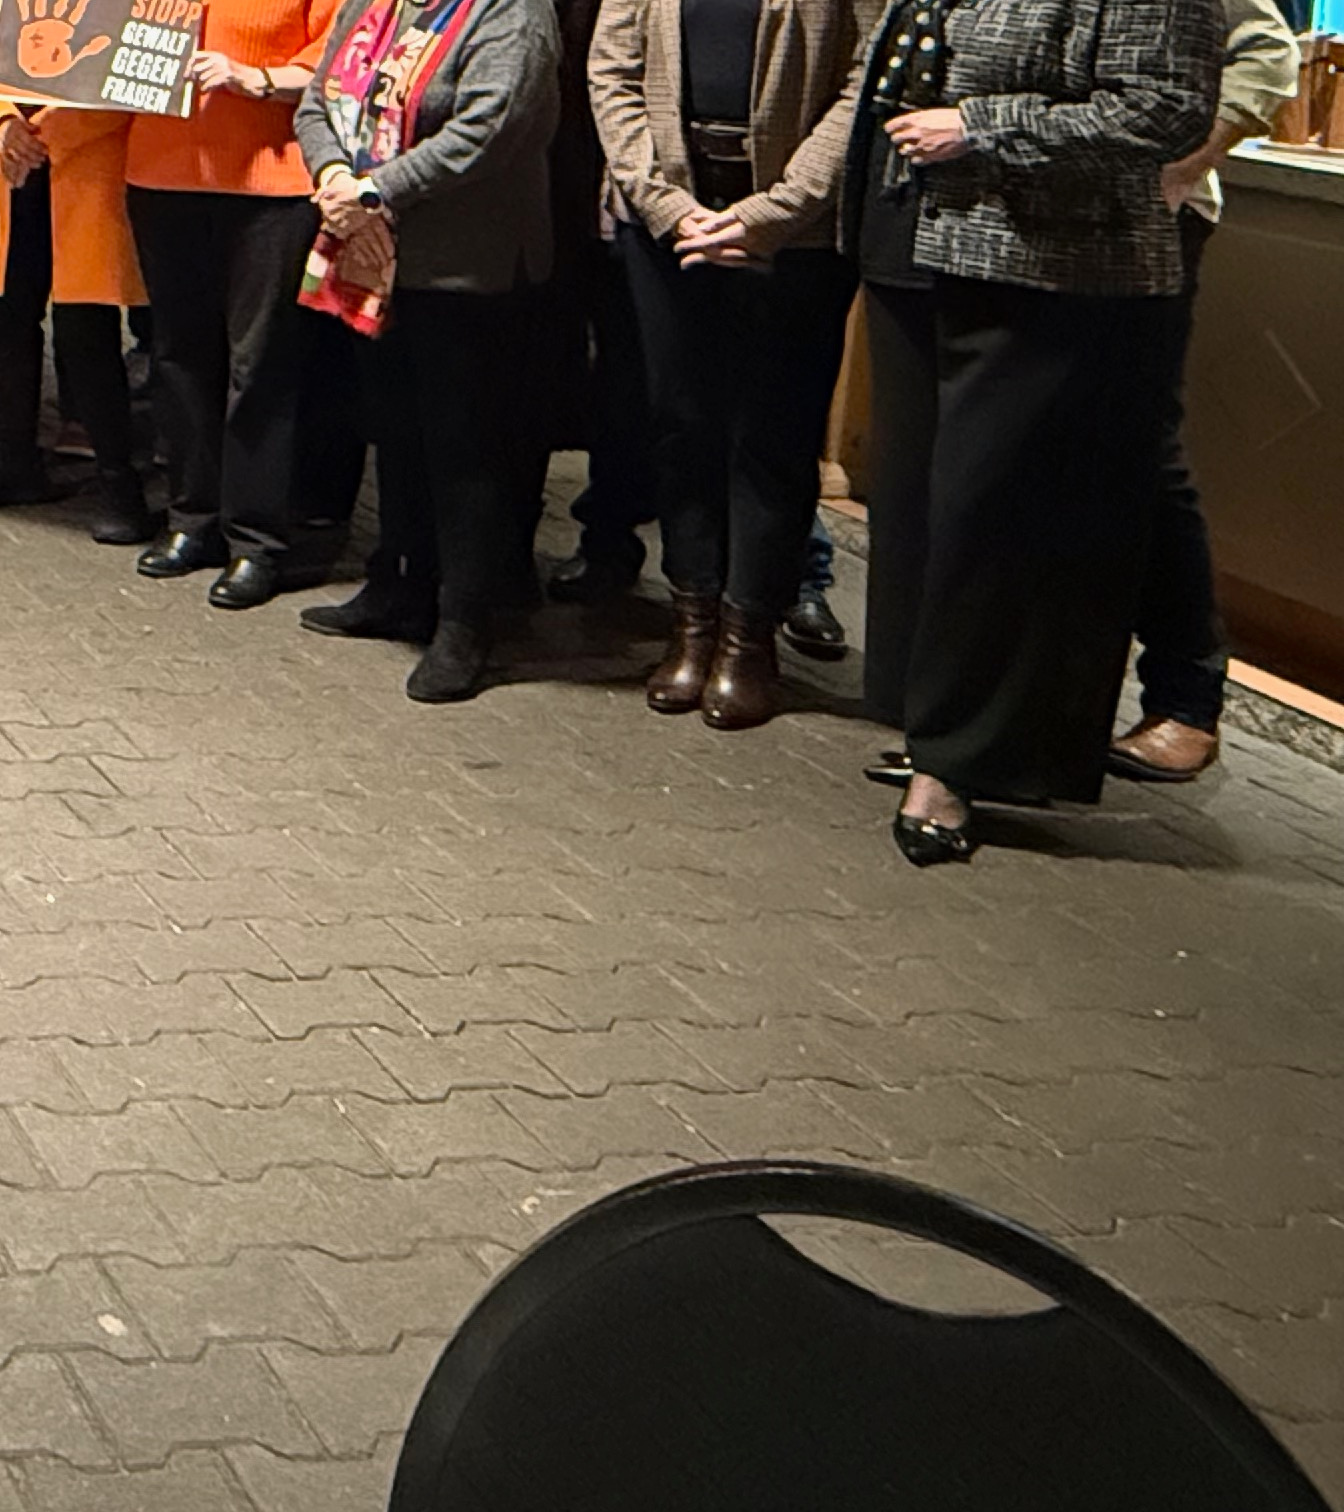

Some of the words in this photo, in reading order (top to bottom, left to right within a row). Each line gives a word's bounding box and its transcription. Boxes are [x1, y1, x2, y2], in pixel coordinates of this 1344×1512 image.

[120, 21, 191, 56] GEWALT
[111, 46, 180, 86] GEGEN
[101, 75, 171, 114] FRAUEN
